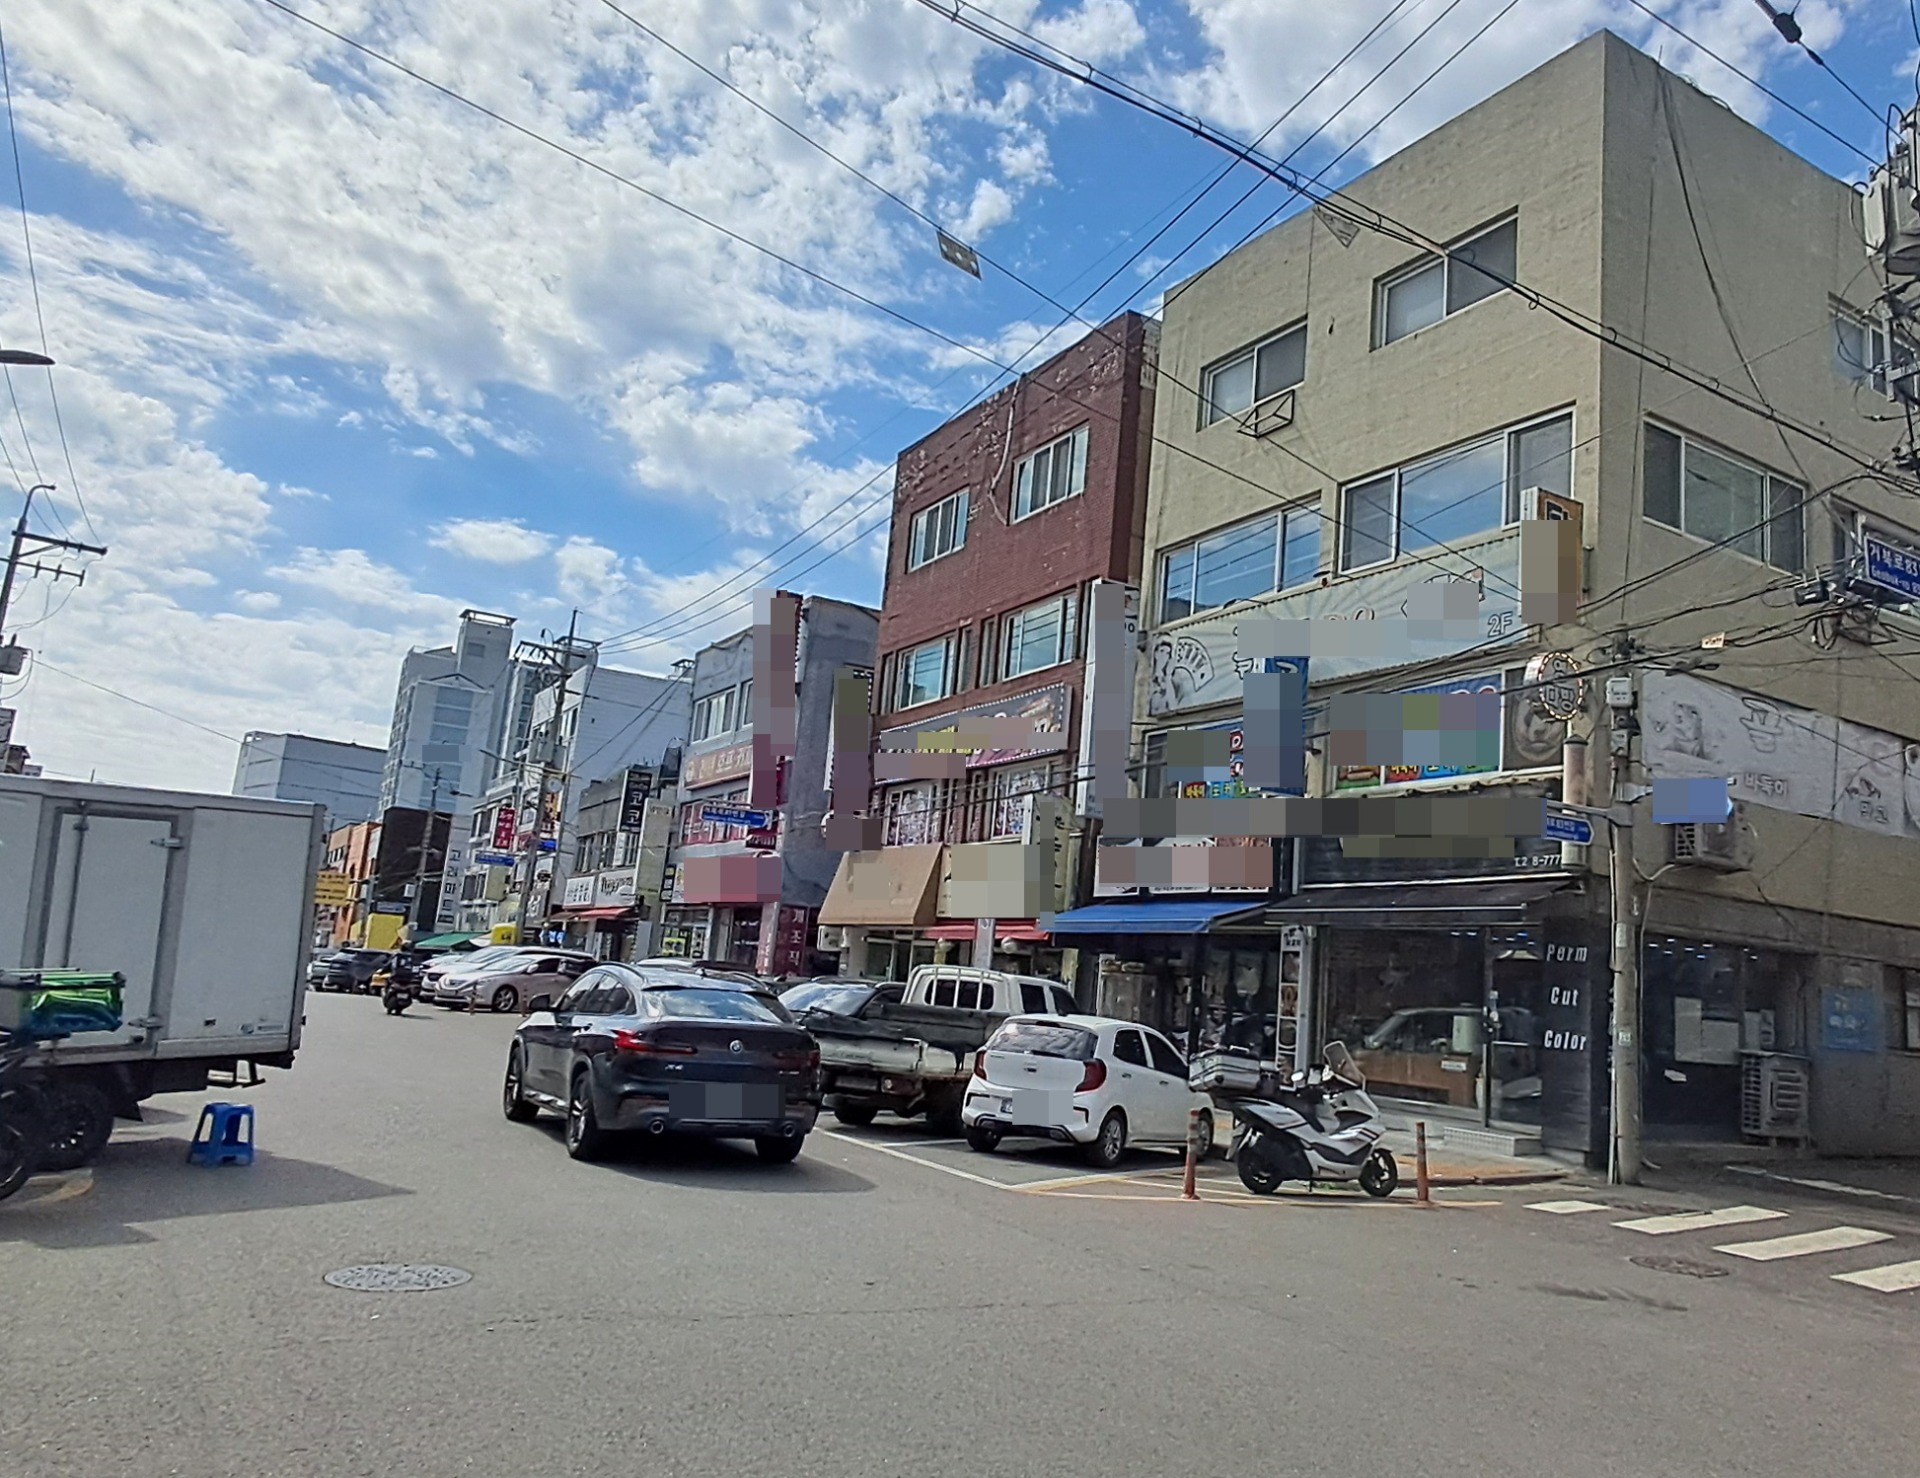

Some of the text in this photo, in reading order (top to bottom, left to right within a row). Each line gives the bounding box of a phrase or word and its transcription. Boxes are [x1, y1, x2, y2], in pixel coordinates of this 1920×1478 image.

[1868, 543, 1920, 578] 거북로83
[1487, 611, 1514, 637] 2F
[1743, 772, 1789, 799] 바둑이
[626, 791, 644, 825] 코코
[1546, 943, 1588, 962] Perm
[1550, 986, 1579, 1006] Cut
[1544, 1029, 1587, 1051] Color
